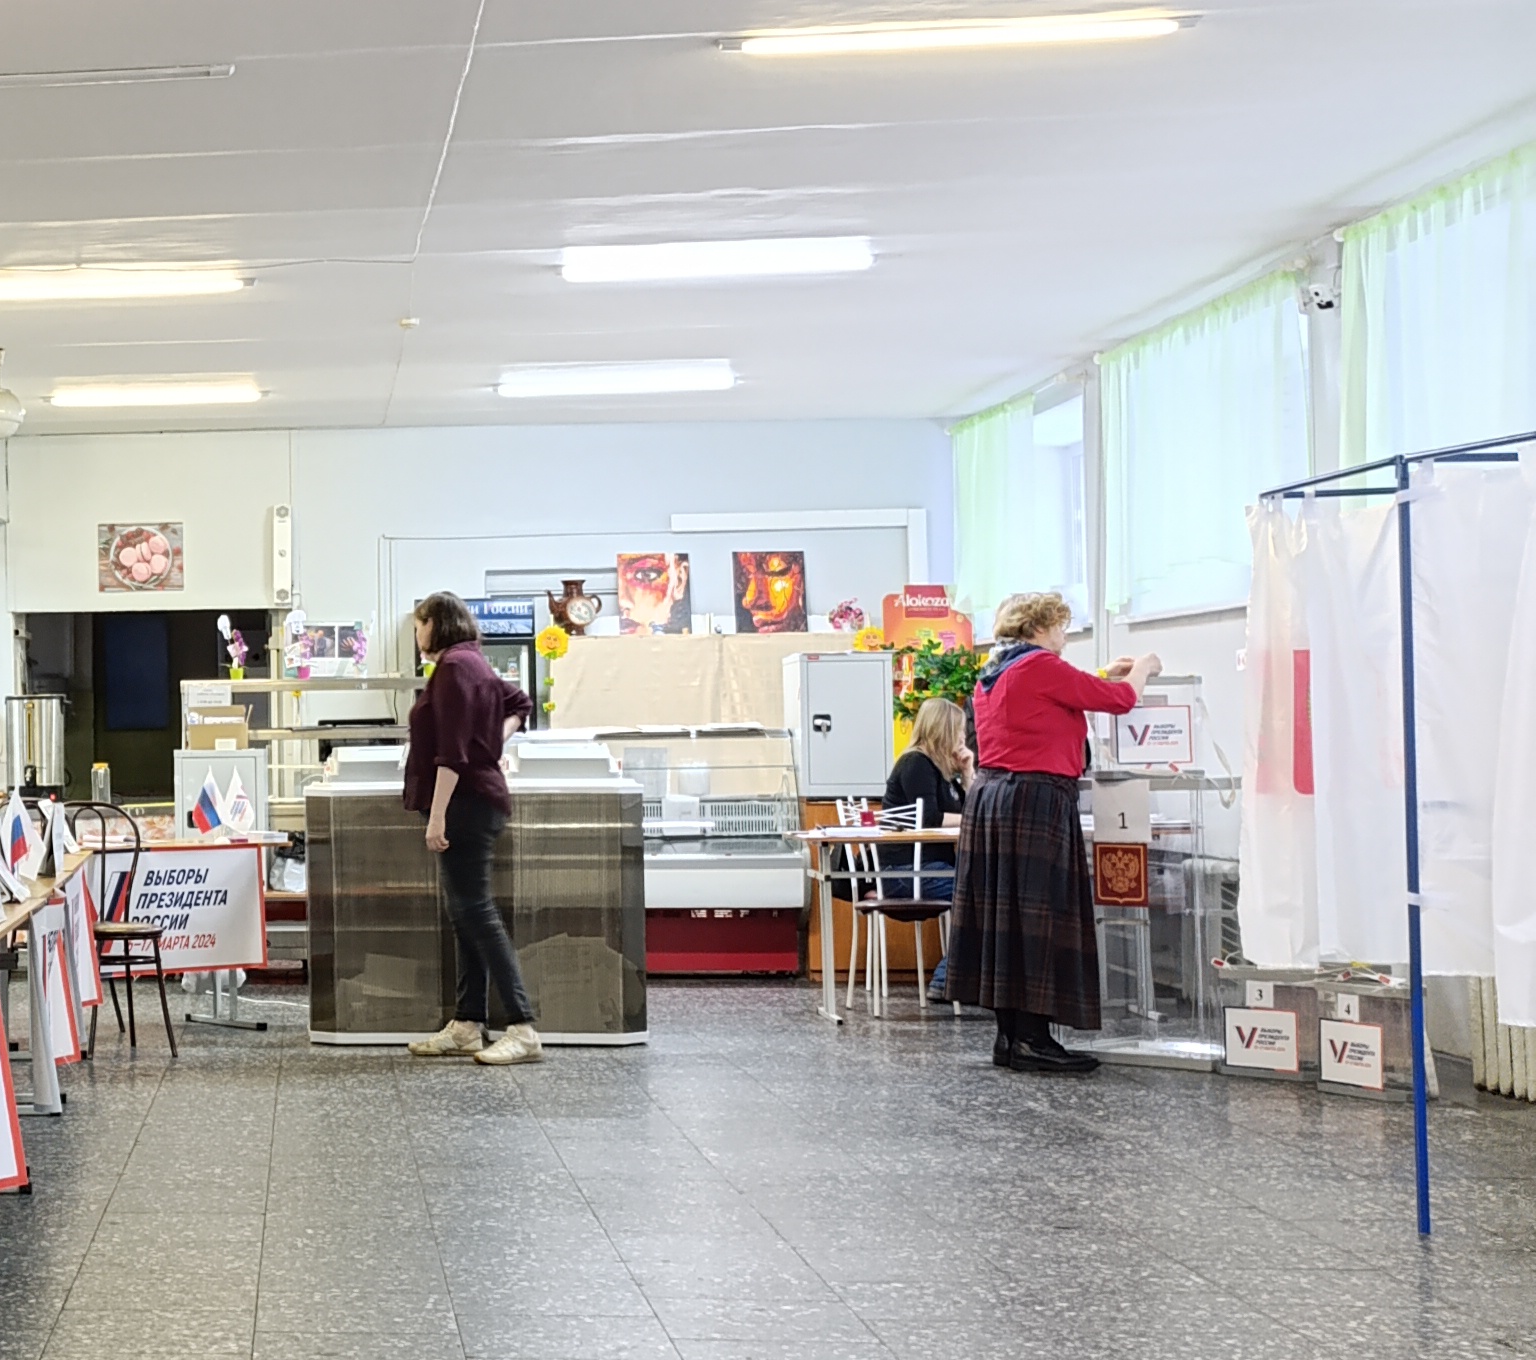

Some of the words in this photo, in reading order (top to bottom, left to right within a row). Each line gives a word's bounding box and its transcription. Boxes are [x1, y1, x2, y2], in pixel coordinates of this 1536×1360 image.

[1118, 812, 1128, 830] 1
[143, 868, 210, 886] ВЫБОРЫ
[135, 889, 228, 910] ПРЕЗИДЕНТА
[191, 932, 217, 949] 2024
[1254, 989, 1263, 1001] 3
[1344, 1003, 1351, 1015] 4
